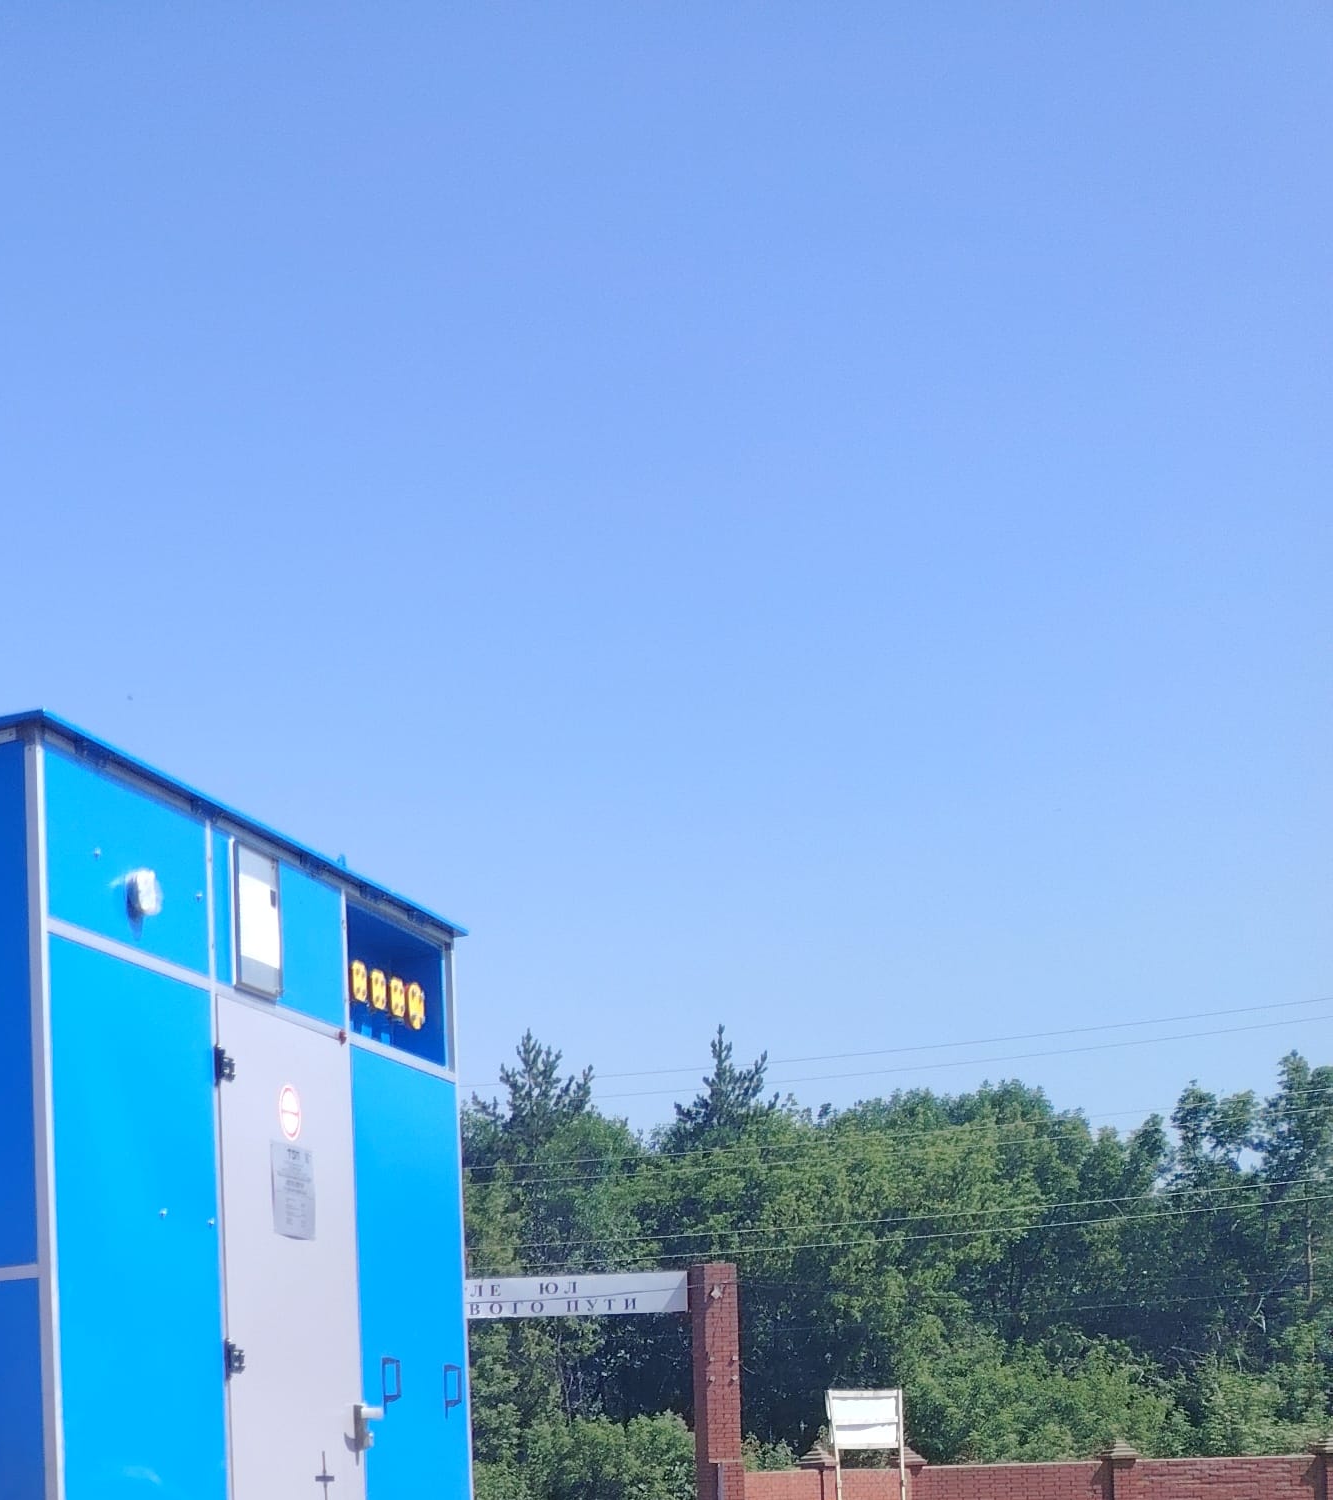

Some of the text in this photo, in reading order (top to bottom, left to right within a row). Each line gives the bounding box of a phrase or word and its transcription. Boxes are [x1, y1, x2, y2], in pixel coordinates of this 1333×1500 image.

[465, 1281, 577, 1298] ЛЕ ЮЛ
[469, 1298, 637, 1316] ВОГО ПУТИ
